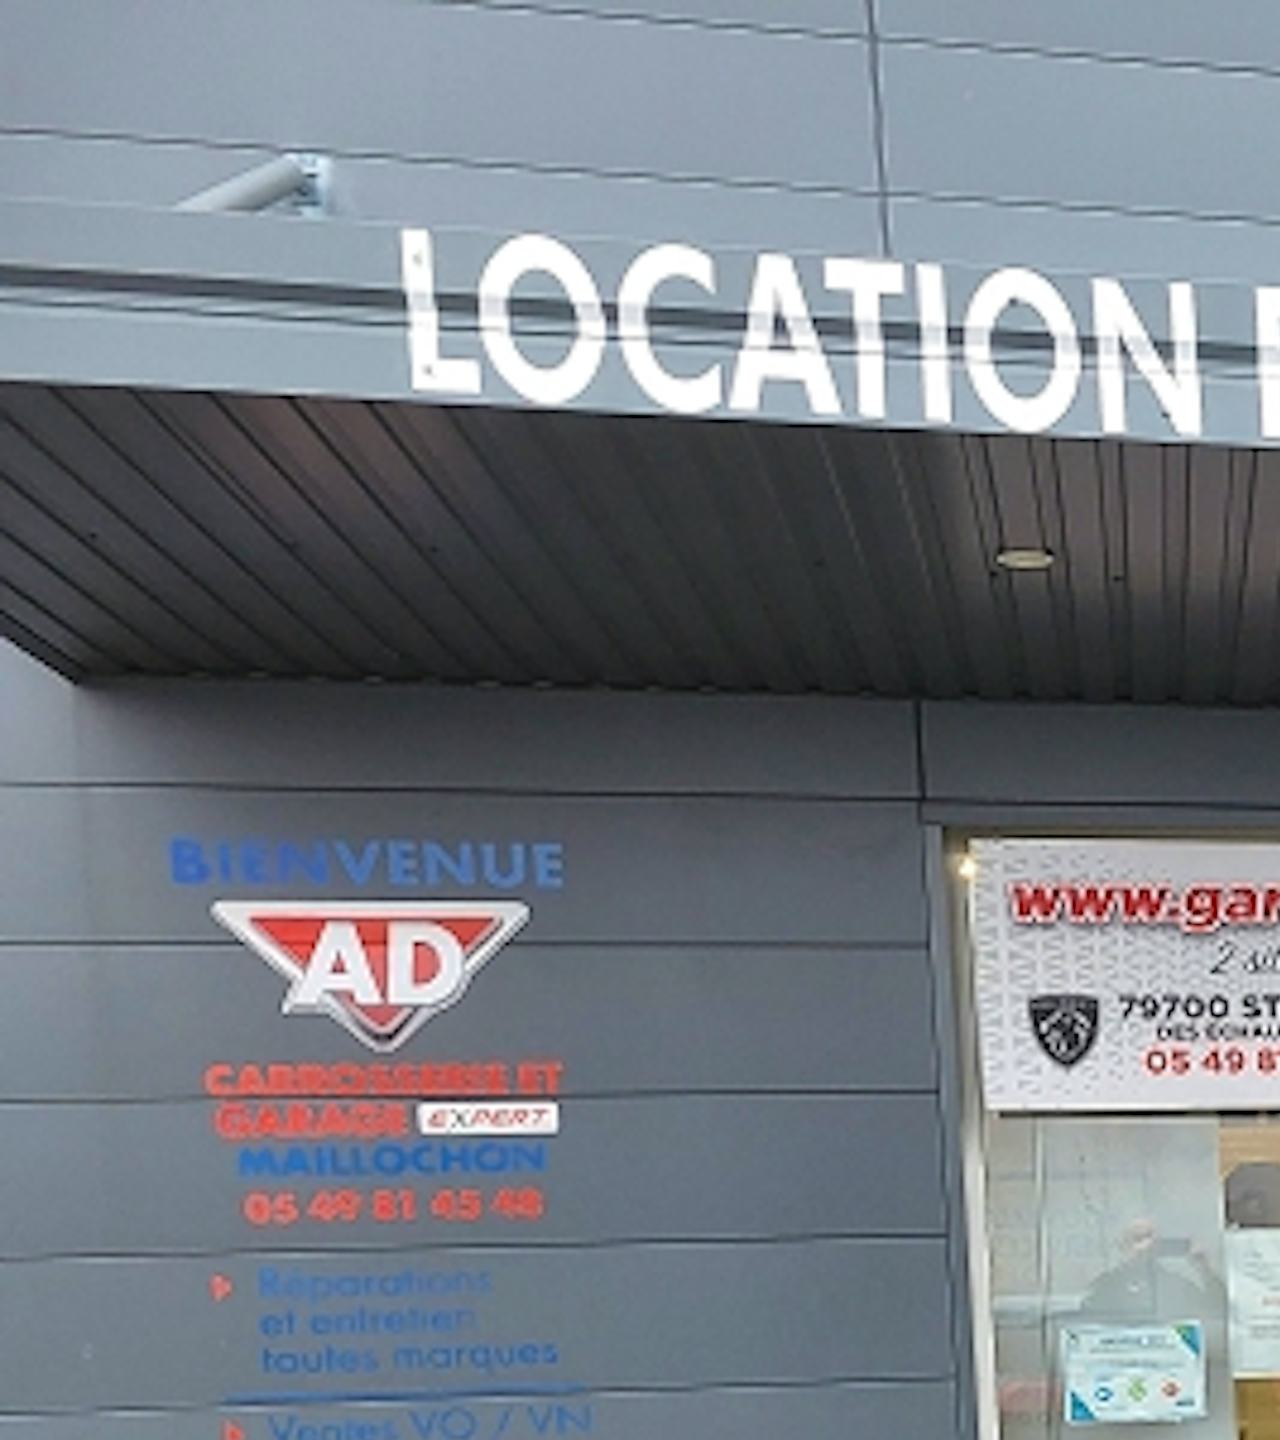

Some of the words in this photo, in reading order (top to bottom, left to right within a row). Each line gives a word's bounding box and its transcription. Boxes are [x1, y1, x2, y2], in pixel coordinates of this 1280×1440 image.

[401, 227, 1202, 437] LOCATION
[170, 837, 565, 889] BIENVENUE
[289, 918, 467, 1007] AD
[1120, 994, 1230, 1018] 79700
[205, 1062, 508, 1097] CARROSSERIE
[517, 1061, 564, 1095] ET
[1146, 1050, 1190, 1073] 05
[1199, 1050, 1244, 1073] 49
[214, 1102, 407, 1139] GARAGE
[426, 1107, 550, 1128] EXPERT
[238, 1142, 547, 1177] MAILLOCHON
[244, 1194, 298, 1224] 05
[308, 1192, 360, 1221] 49
[371, 1190, 415, 1220] 81
[431, 1189, 481, 1219] 45
[491, 1188, 542, 1219] 48
[258, 1266, 493, 1304] Réparations
[261, 1309, 297, 1337] et
[310, 1306, 479, 1336] entretien
[261, 1347, 380, 1374] toutes
[394, 1339, 559, 1372] marques
[409, 1405, 477, 1440] VO
[528, 1404, 595, 1434] VN
